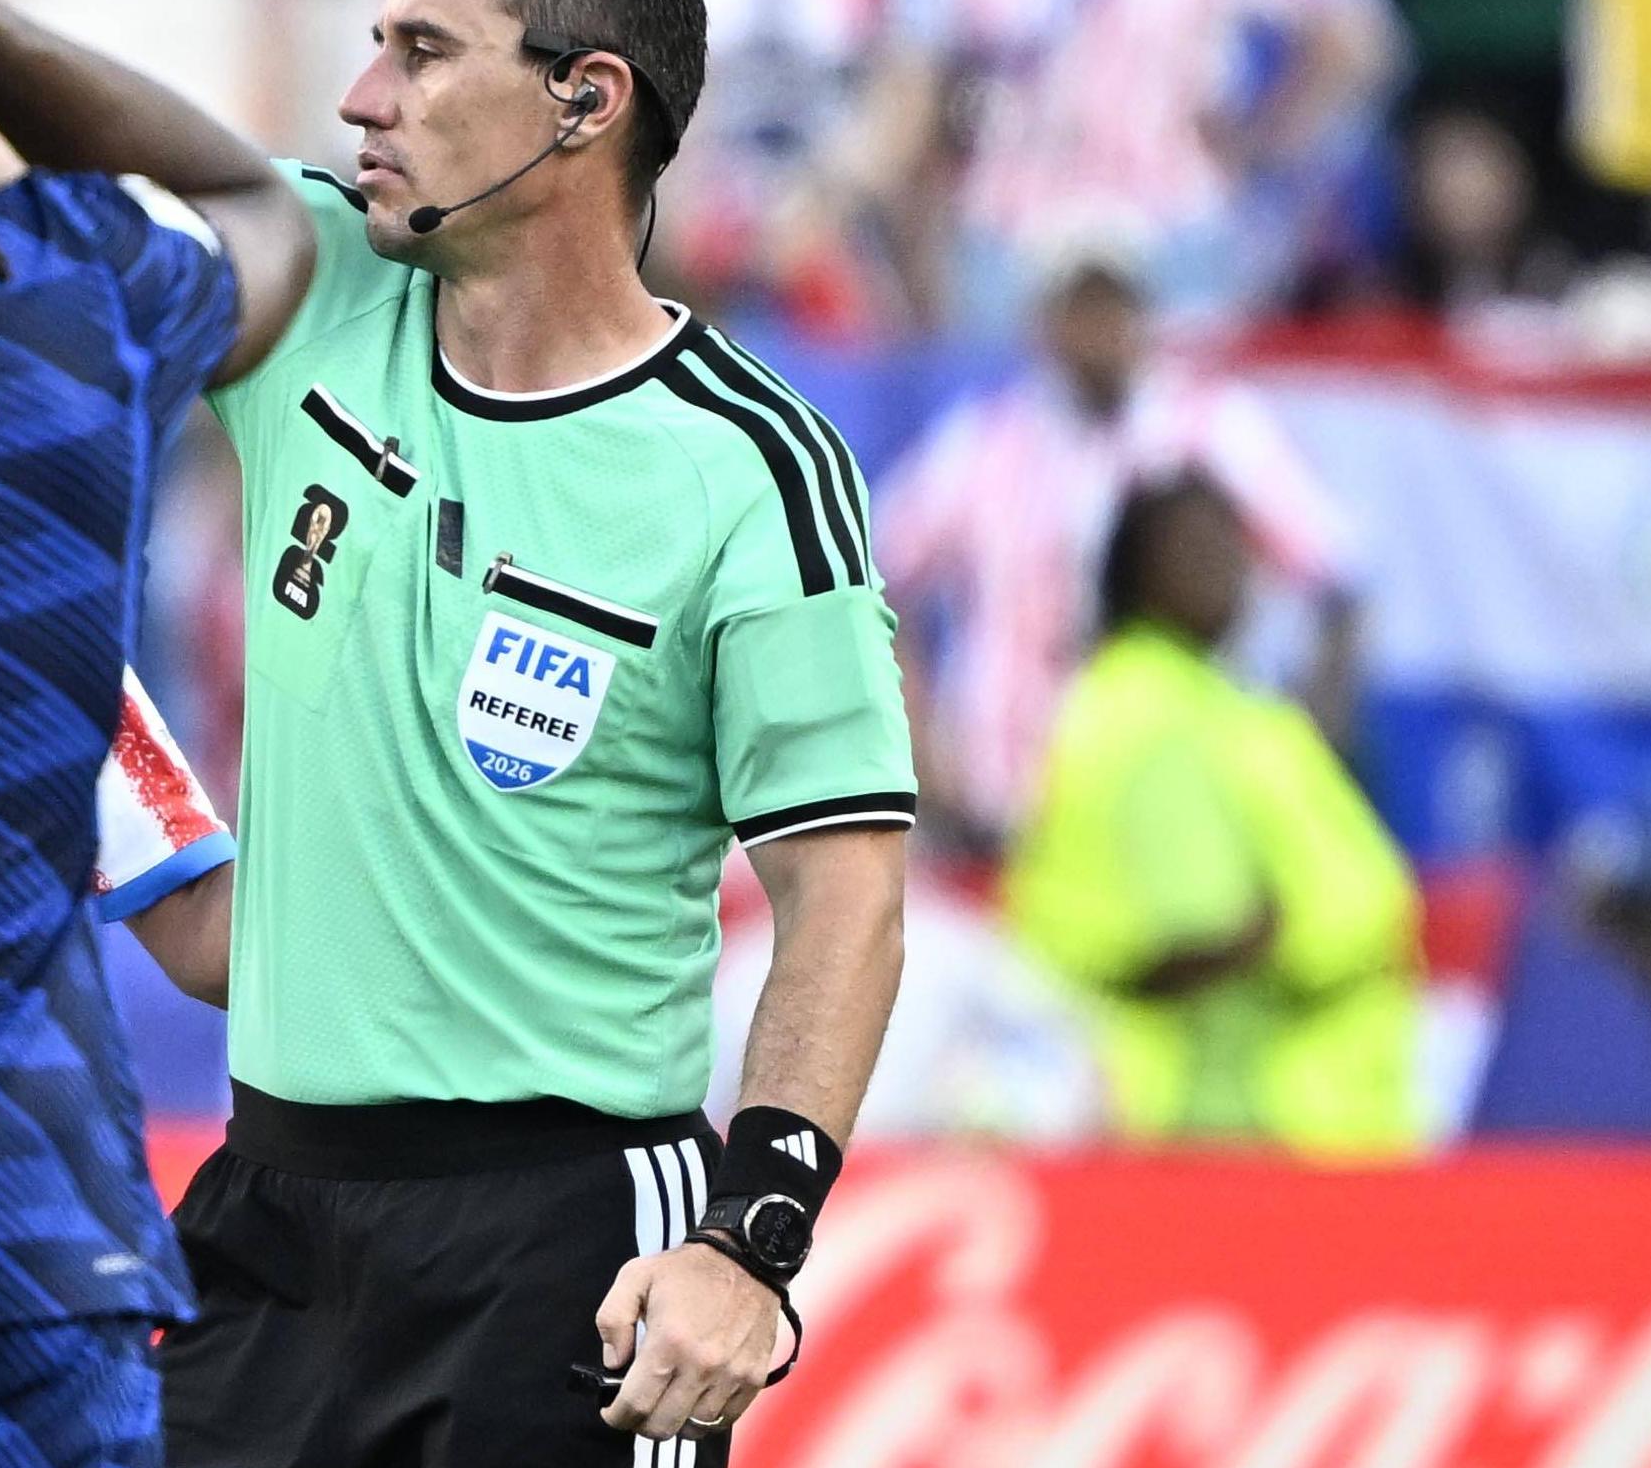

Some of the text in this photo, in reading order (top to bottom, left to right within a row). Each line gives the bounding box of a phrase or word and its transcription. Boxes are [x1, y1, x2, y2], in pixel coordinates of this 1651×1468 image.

[486, 627, 590, 698] FIFA
[470, 690, 579, 742] REFEREE
[481, 751, 534, 782] 2026
